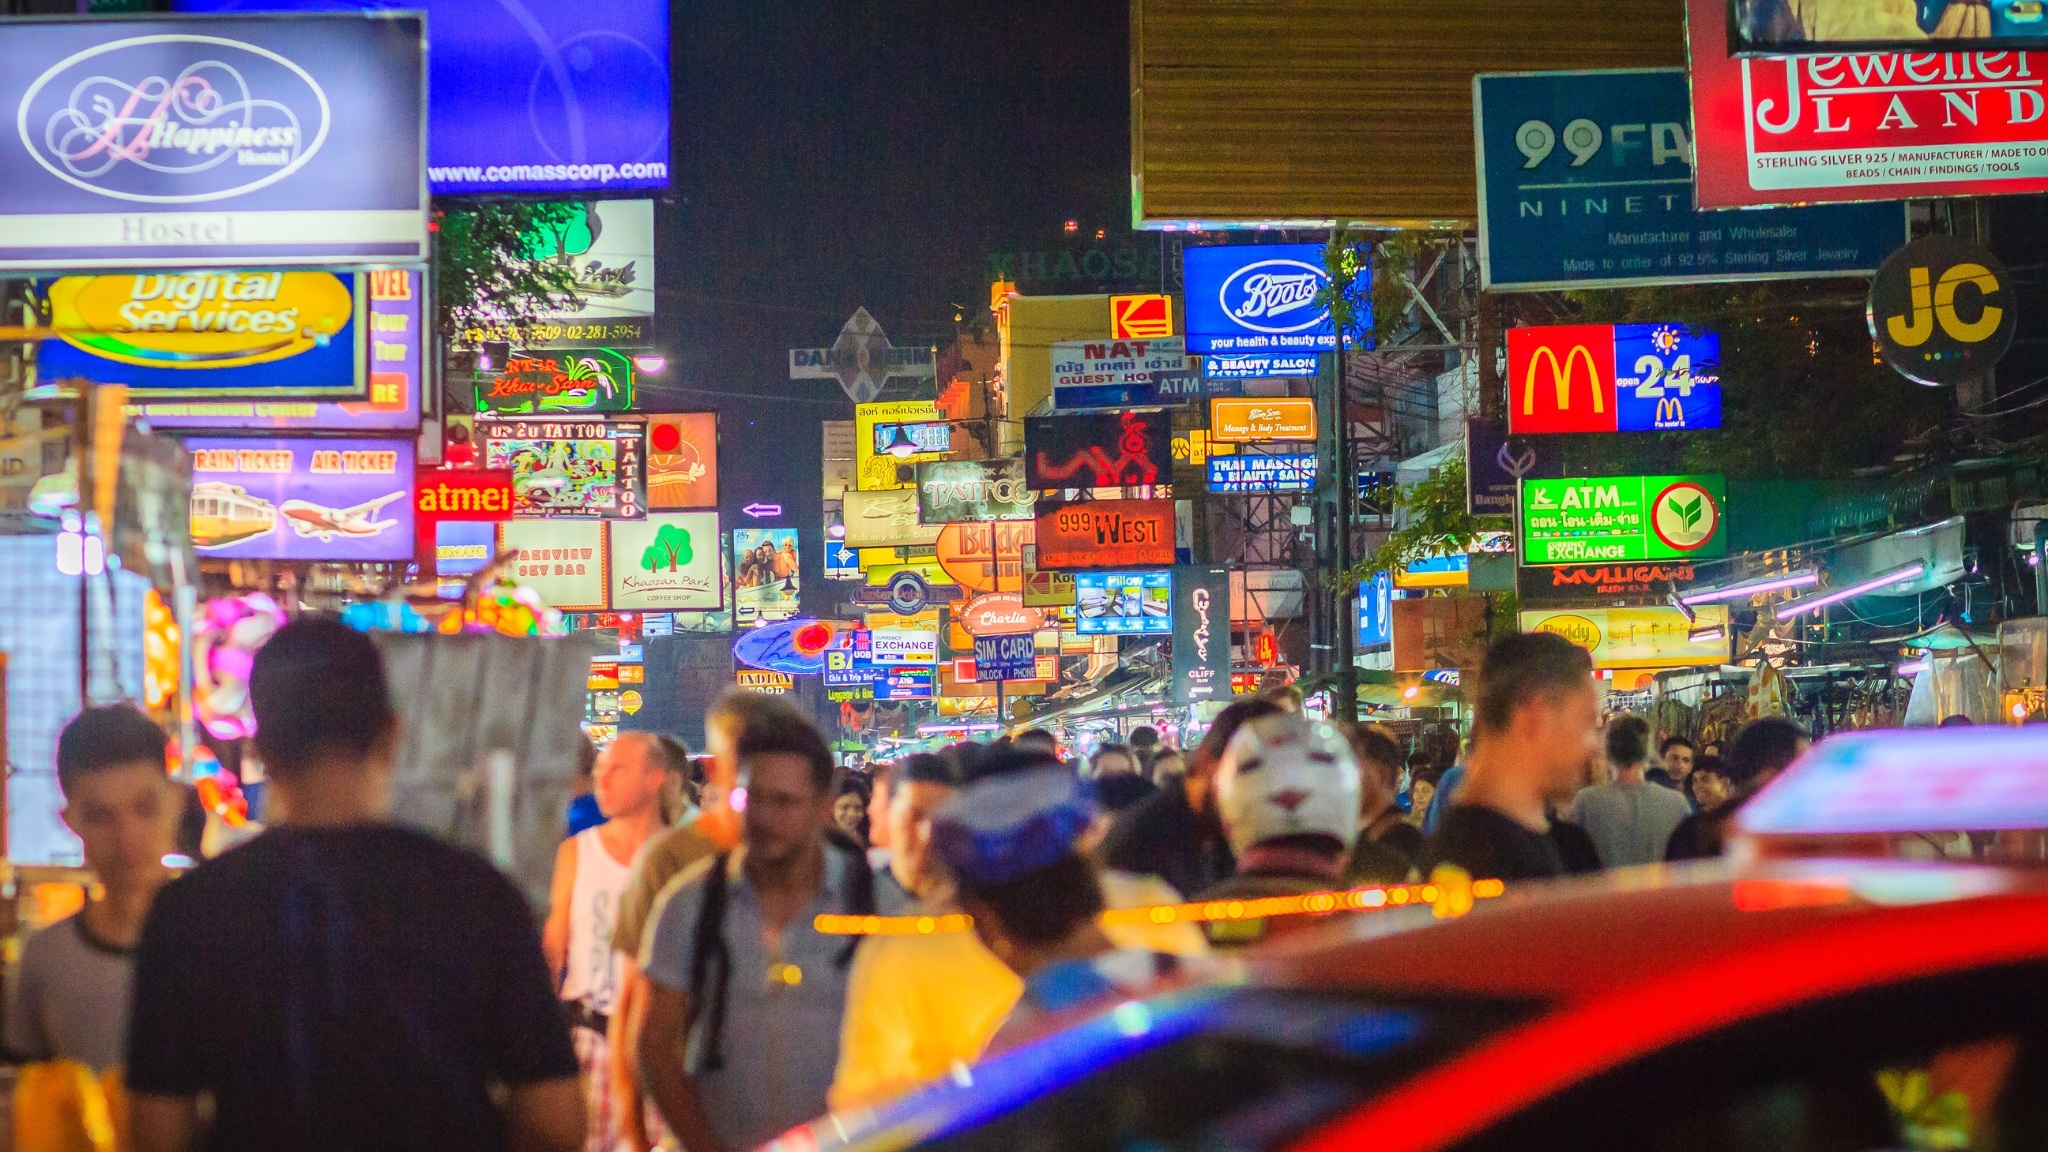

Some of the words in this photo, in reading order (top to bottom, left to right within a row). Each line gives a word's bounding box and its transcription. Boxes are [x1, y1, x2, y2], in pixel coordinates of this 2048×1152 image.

[1811, 89, 2045, 133] LAND
[149, 117, 296, 154] Happiness
[1757, 156, 1817, 169] STERLING
[1820, 153, 1862, 166] SILVER
[1865, 152, 1888, 164] 925
[1898, 149, 1982, 162] MANUFACTURER
[1991, 147, 2021, 158] MADE
[2023, 146, 2036, 157] TO
[428, 161, 666, 184] www.comasscorp.com
[1846, 167, 1880, 179] BEADS
[1888, 166, 1921, 177] CHAIN
[1929, 164, 1979, 175] FINDINGS
[1987, 162, 2020, 173] TOOLS
[122, 216, 234, 243] Hostel
[1608, 231, 1690, 245] Manufacturer
[1700, 229, 1721, 241] and
[130, 272, 285, 309] Digital
[1235, 273, 1318, 318] Boots
[1887, 263, 2003, 347] JC
[119, 302, 298, 334] Services
[1211, 338, 1234, 349] your
[1236, 335, 1268, 347] health
[1270, 337, 1278, 346] &
[1280, 334, 1315, 346] beauty
[1084, 341, 1151, 359] NAT
[1208, 361, 1218, 370] &
[1221, 359, 1270, 369] BEAUTY
[1273, 358, 1315, 368] SALON
[1059, 374, 1115, 385] GUEST
[1617, 377, 1640, 387] open
[1634, 354, 1692, 398] 24
[1159, 377, 1199, 394] ATM
[543, 423, 607, 438] TATTOO
[1223, 424, 1249, 435] Massage
[1258, 423, 1273, 434] Body
[238, 450, 293, 473] TICKET
[311, 451, 343, 473] AIR
[343, 450, 397, 473] TICKET
[1213, 459, 1246, 471] THAI
[1560, 485, 1621, 510] ATM
[1059, 513, 1091, 533] 999
[851, 531, 887, 543] Balcony
[889, 531, 911, 540] View
[1547, 546, 1625, 559] EXCHANGE
[519, 565, 549, 577] SKY
[555, 564, 586, 576] BAR
[622, 575, 678, 590] Khaosan
[681, 576, 710, 588] Park
[1107, 575, 1144, 586] Pillow
[980, 611, 1027, 626] Charlie
[875, 641, 934, 650] EXCHANGE
[975, 639, 997, 660] SIM
[1000, 637, 1035, 659] CARD
[853, 650, 872, 659] UOB
[740, 672, 793, 685] INDIAN
[976, 669, 1003, 681] UNLOCK
[1013, 667, 1036, 679] PHONE
[1188, 670, 1215, 678] CLIFF
